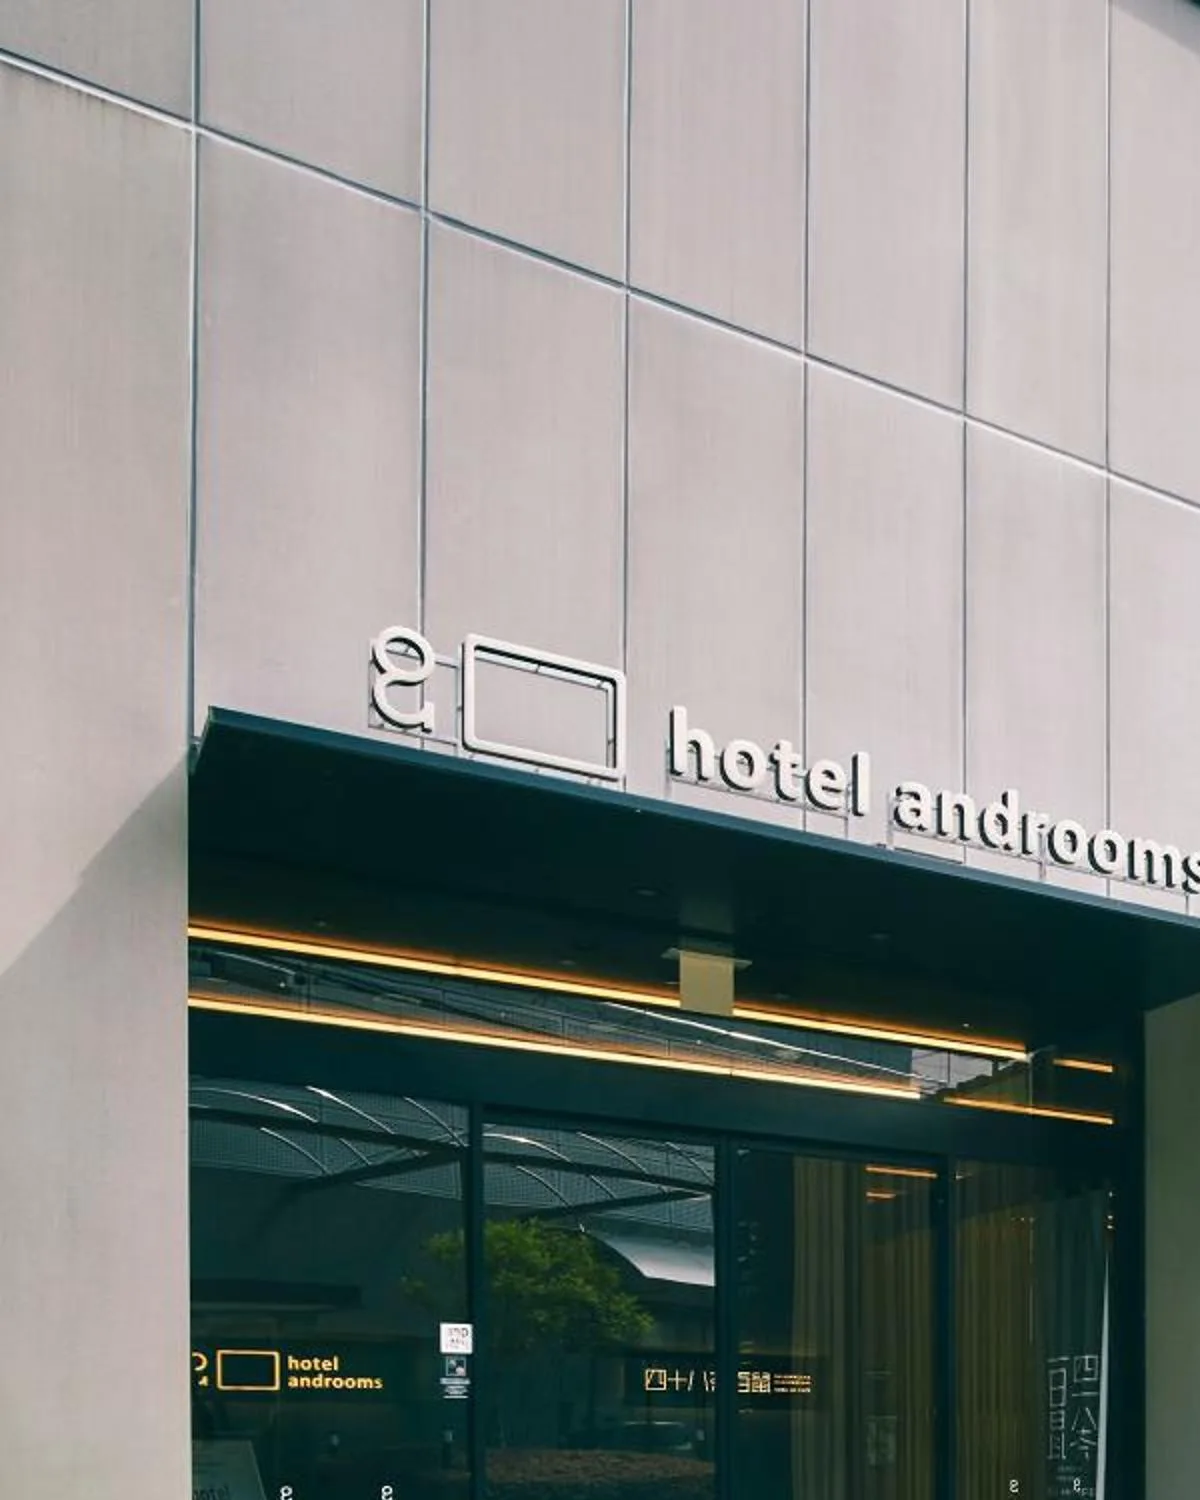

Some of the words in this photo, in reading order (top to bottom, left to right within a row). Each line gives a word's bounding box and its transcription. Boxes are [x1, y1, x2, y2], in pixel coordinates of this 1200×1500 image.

[669, 704, 870, 816] hotel
[287, 1355, 339, 1372] hotel
[287, 1374, 383, 1389] androoms
